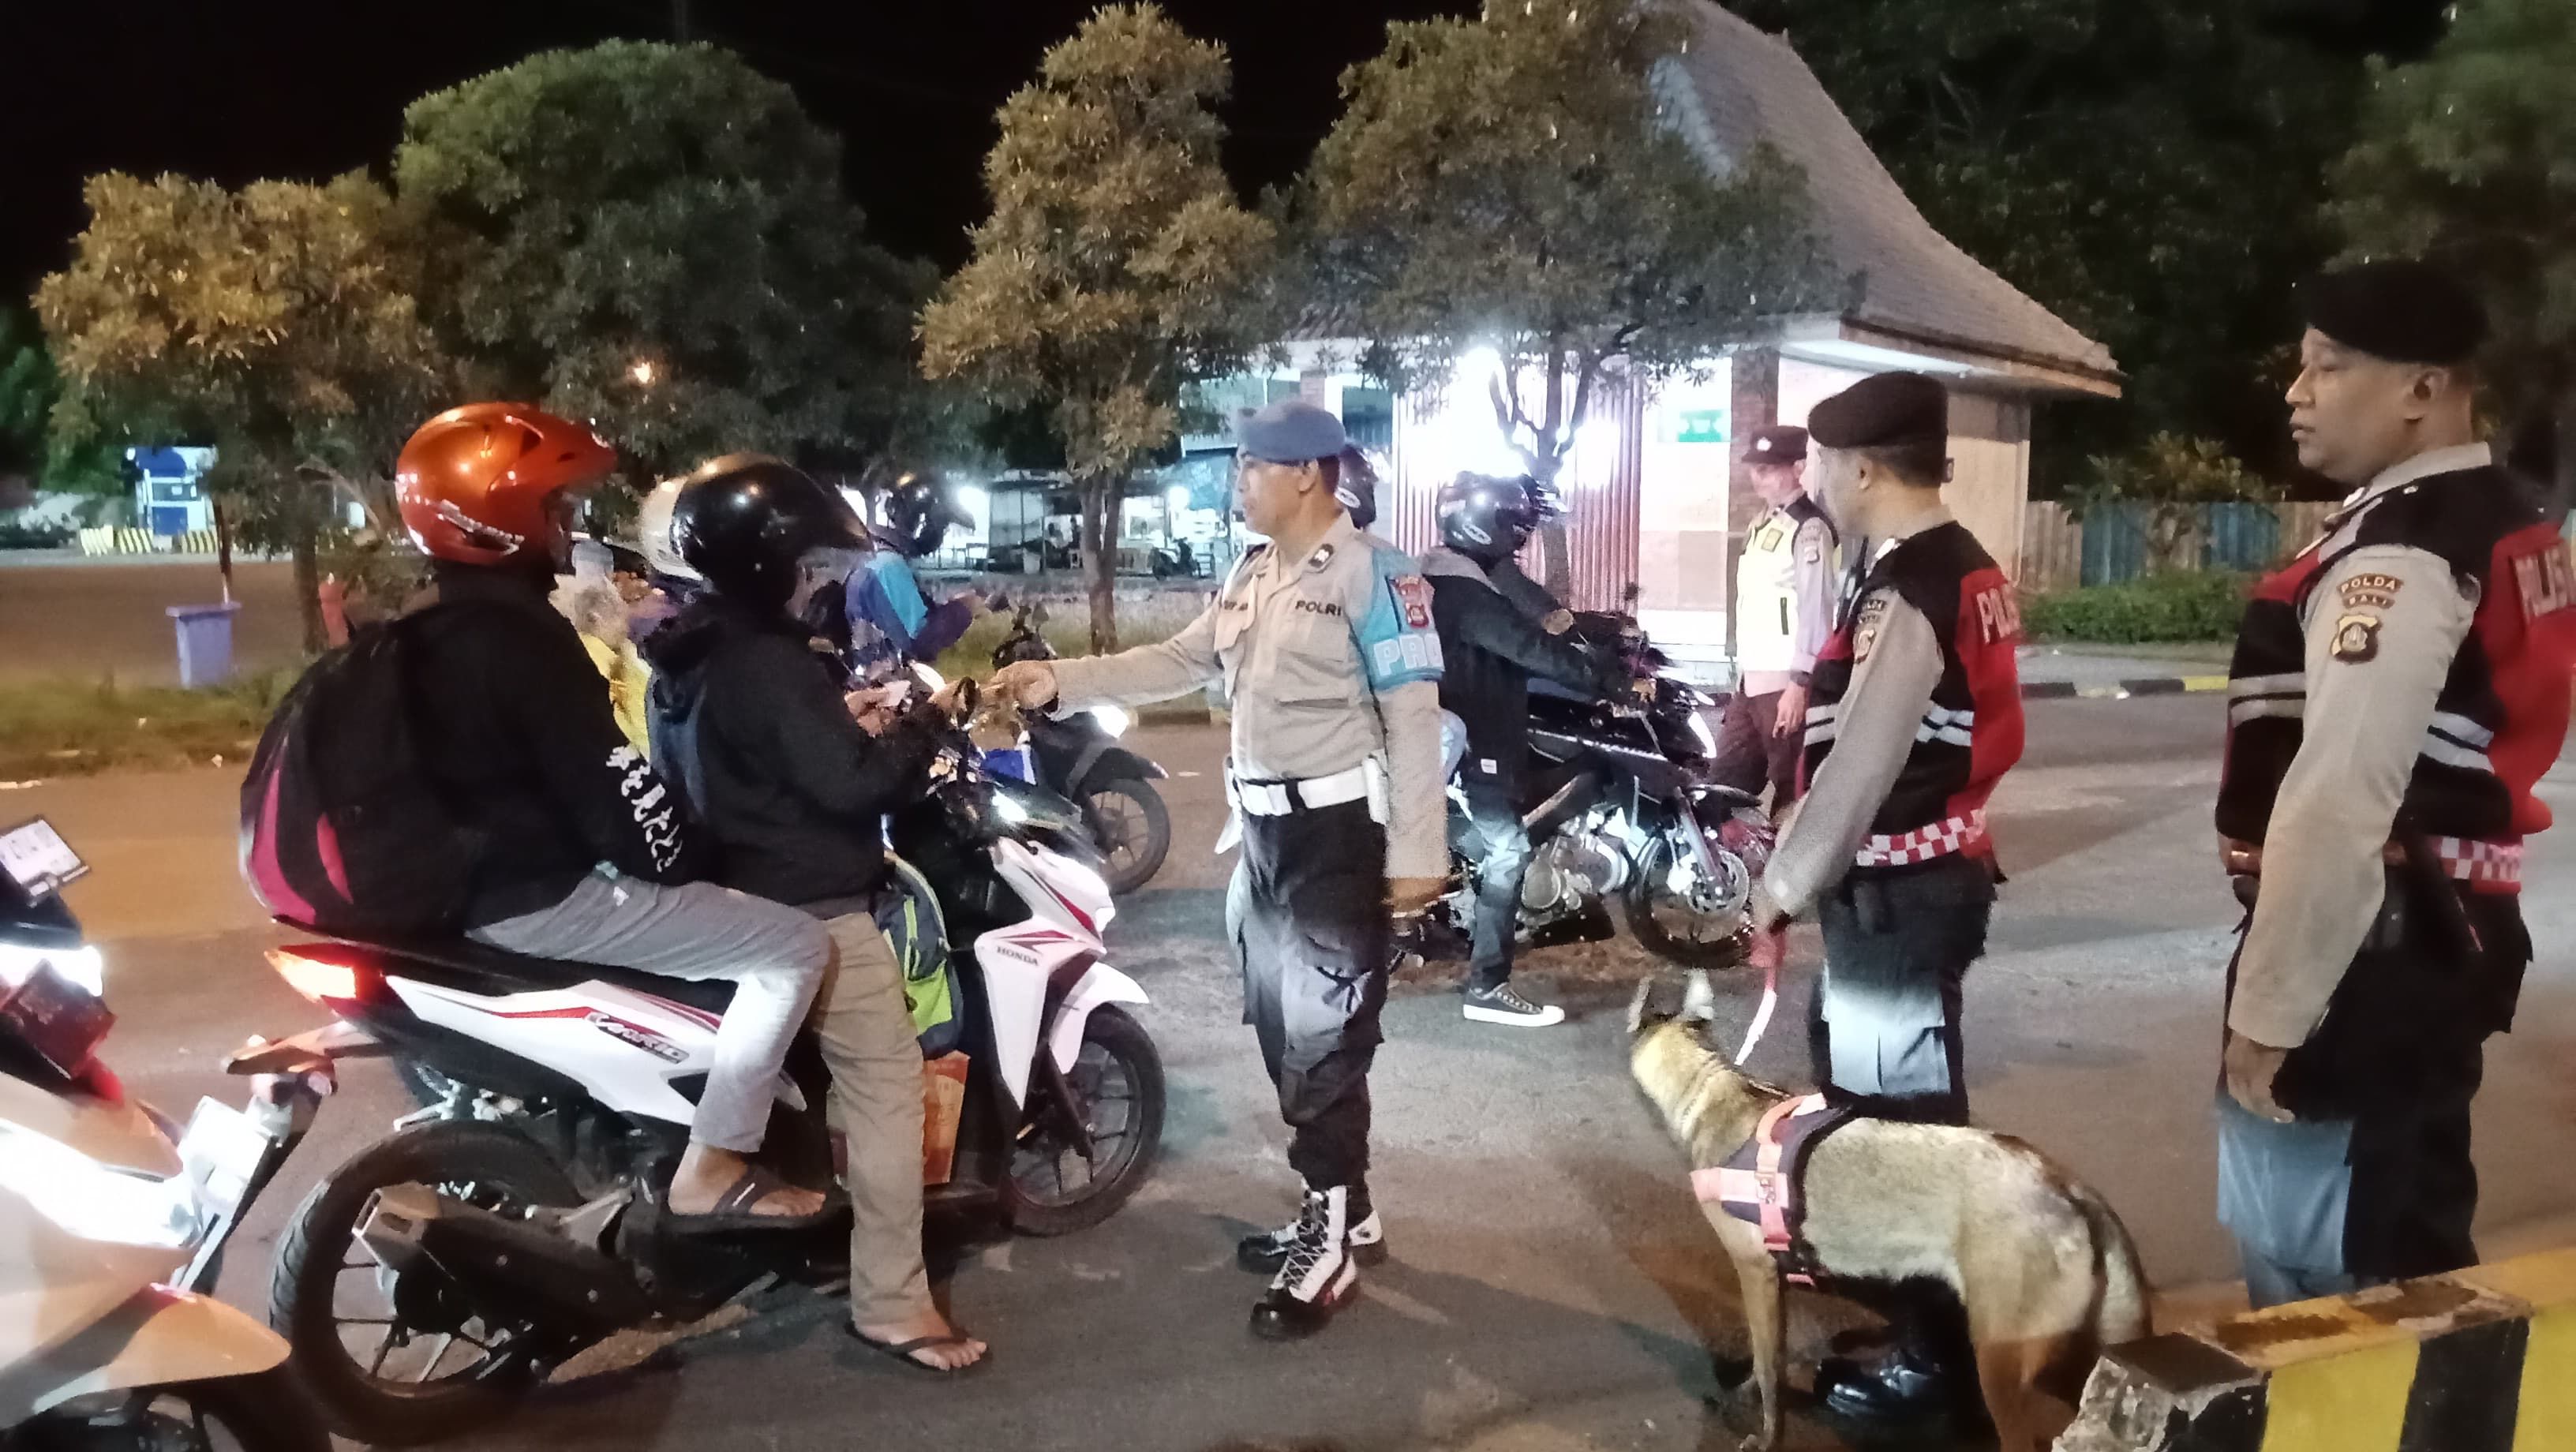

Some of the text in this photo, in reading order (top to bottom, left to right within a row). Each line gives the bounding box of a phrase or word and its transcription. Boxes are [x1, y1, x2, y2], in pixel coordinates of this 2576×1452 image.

[2341, 576, 2396, 593] POLDA
[2349, 594, 2388, 605] BALI
[1295, 600, 1342, 616] POLRI
[997, 946, 1039, 966] HONDA
